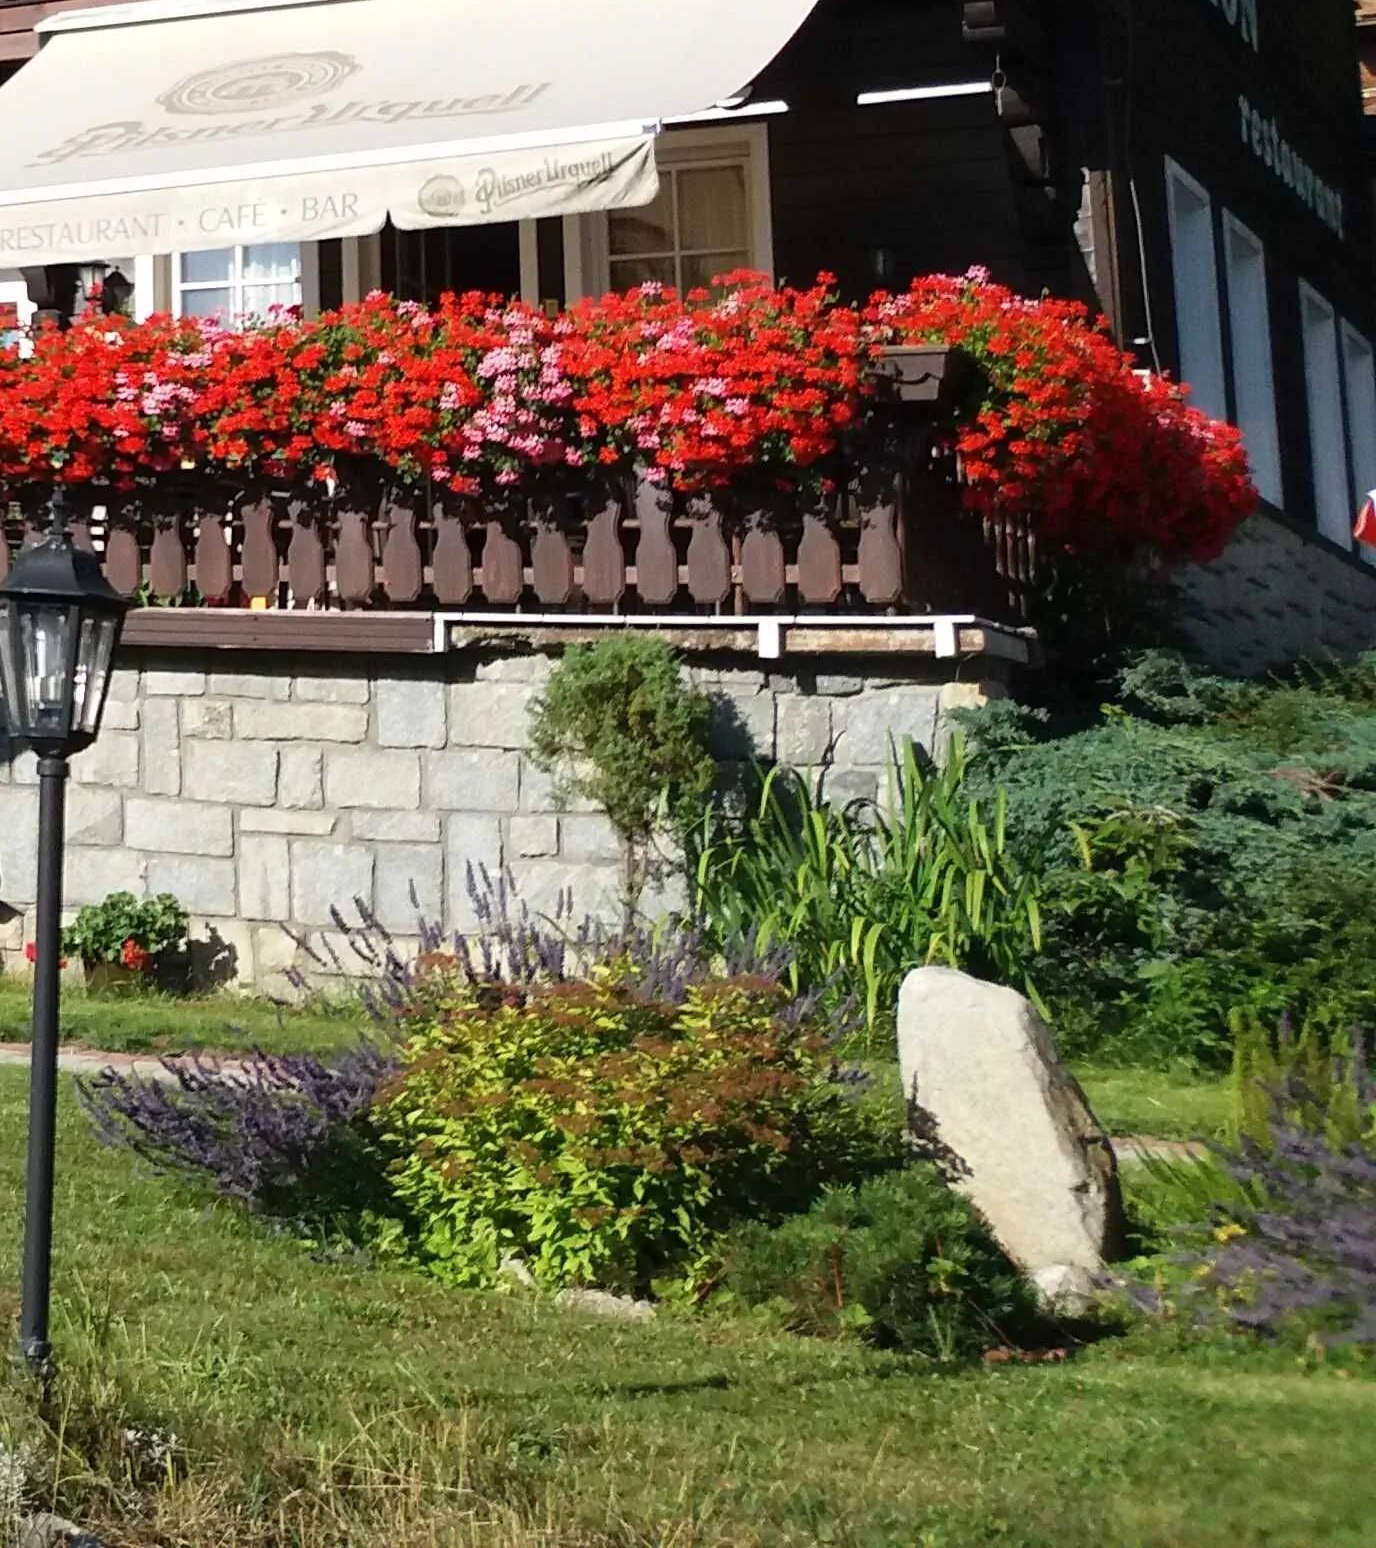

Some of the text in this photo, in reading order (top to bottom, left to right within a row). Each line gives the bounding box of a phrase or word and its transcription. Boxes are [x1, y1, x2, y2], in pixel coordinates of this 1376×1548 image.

[24, 81, 552, 168] Pilsner Urquell
[474, 151, 613, 214] Pilsner Urquell
[0, 192, 360, 251] RESTAURANT CAFÉ BAR
